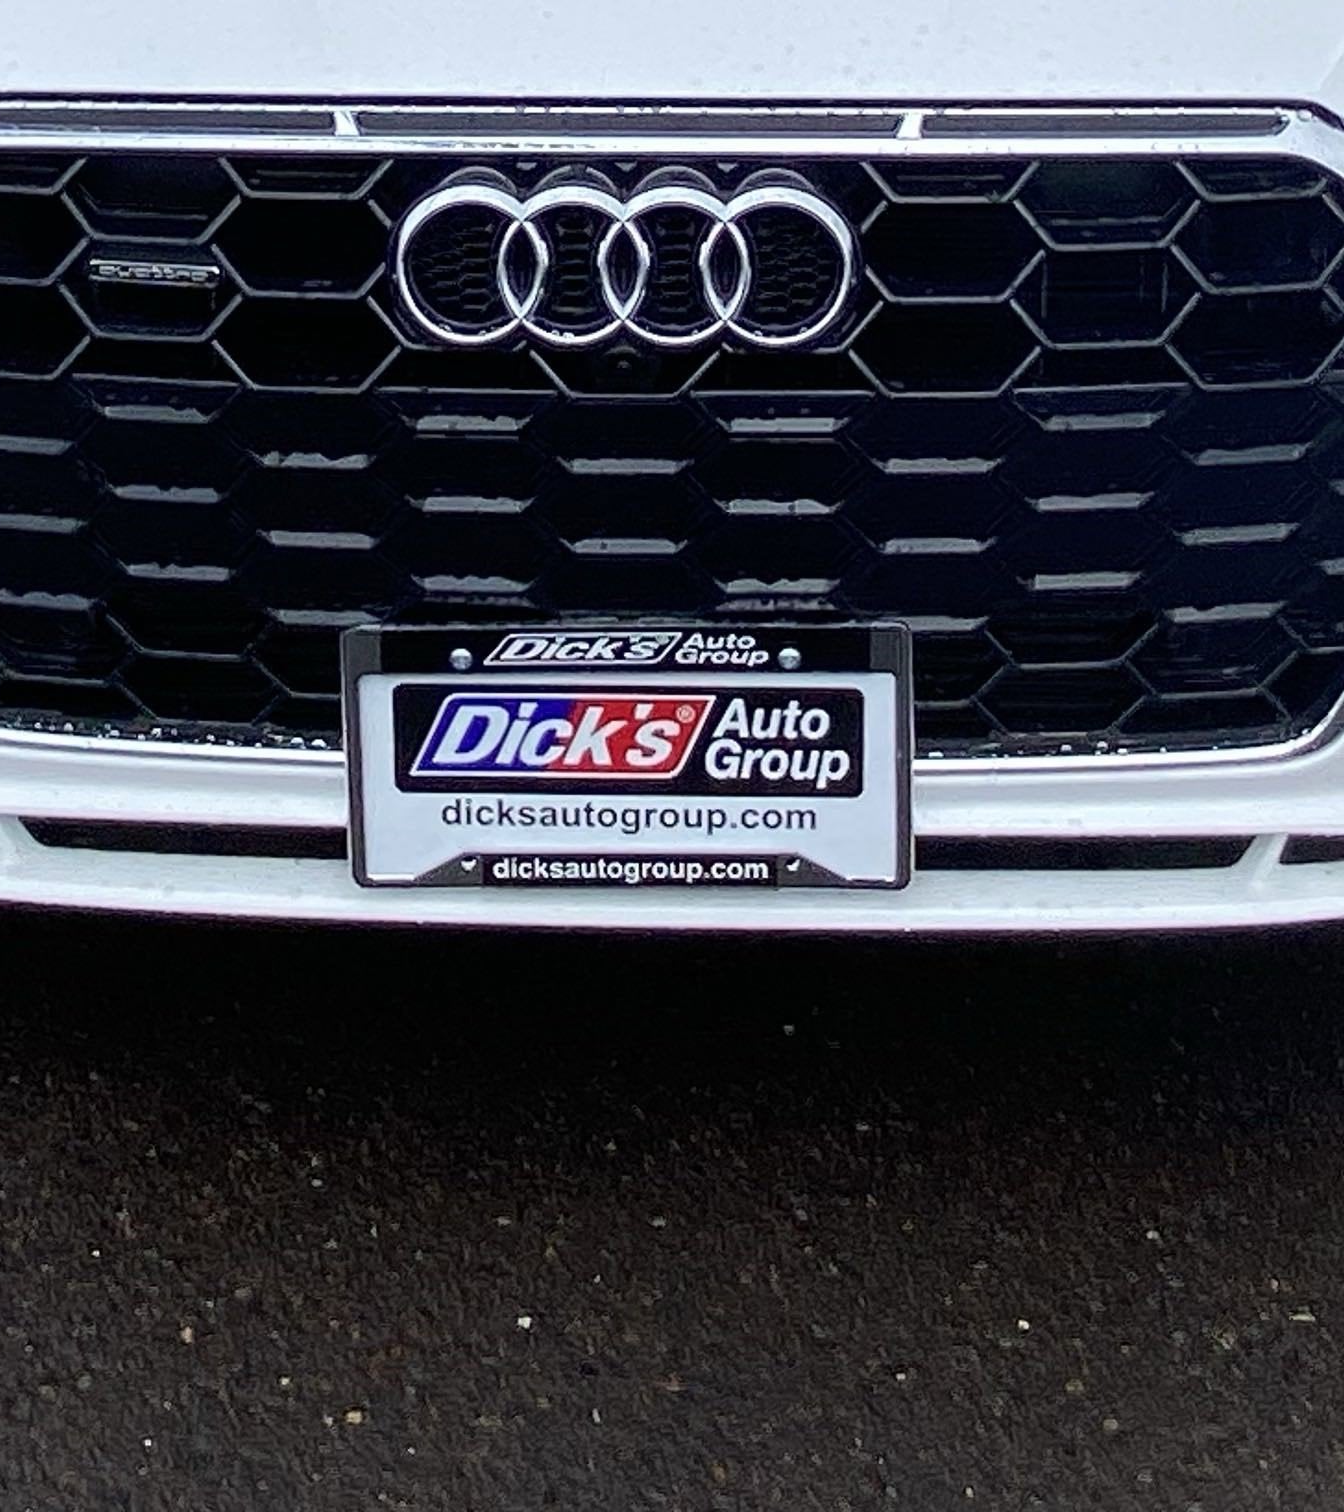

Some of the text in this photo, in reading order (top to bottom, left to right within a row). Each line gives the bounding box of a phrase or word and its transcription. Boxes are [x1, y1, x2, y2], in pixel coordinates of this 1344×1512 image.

[682, 632, 757, 650] Auto
[674, 648, 770, 667] Group
[710, 697, 830, 741] Auto
[704, 739, 852, 789] Group
[441, 798, 818, 835] dicksautogroup.com
[492, 857, 770, 885] dicksautogroup.com
